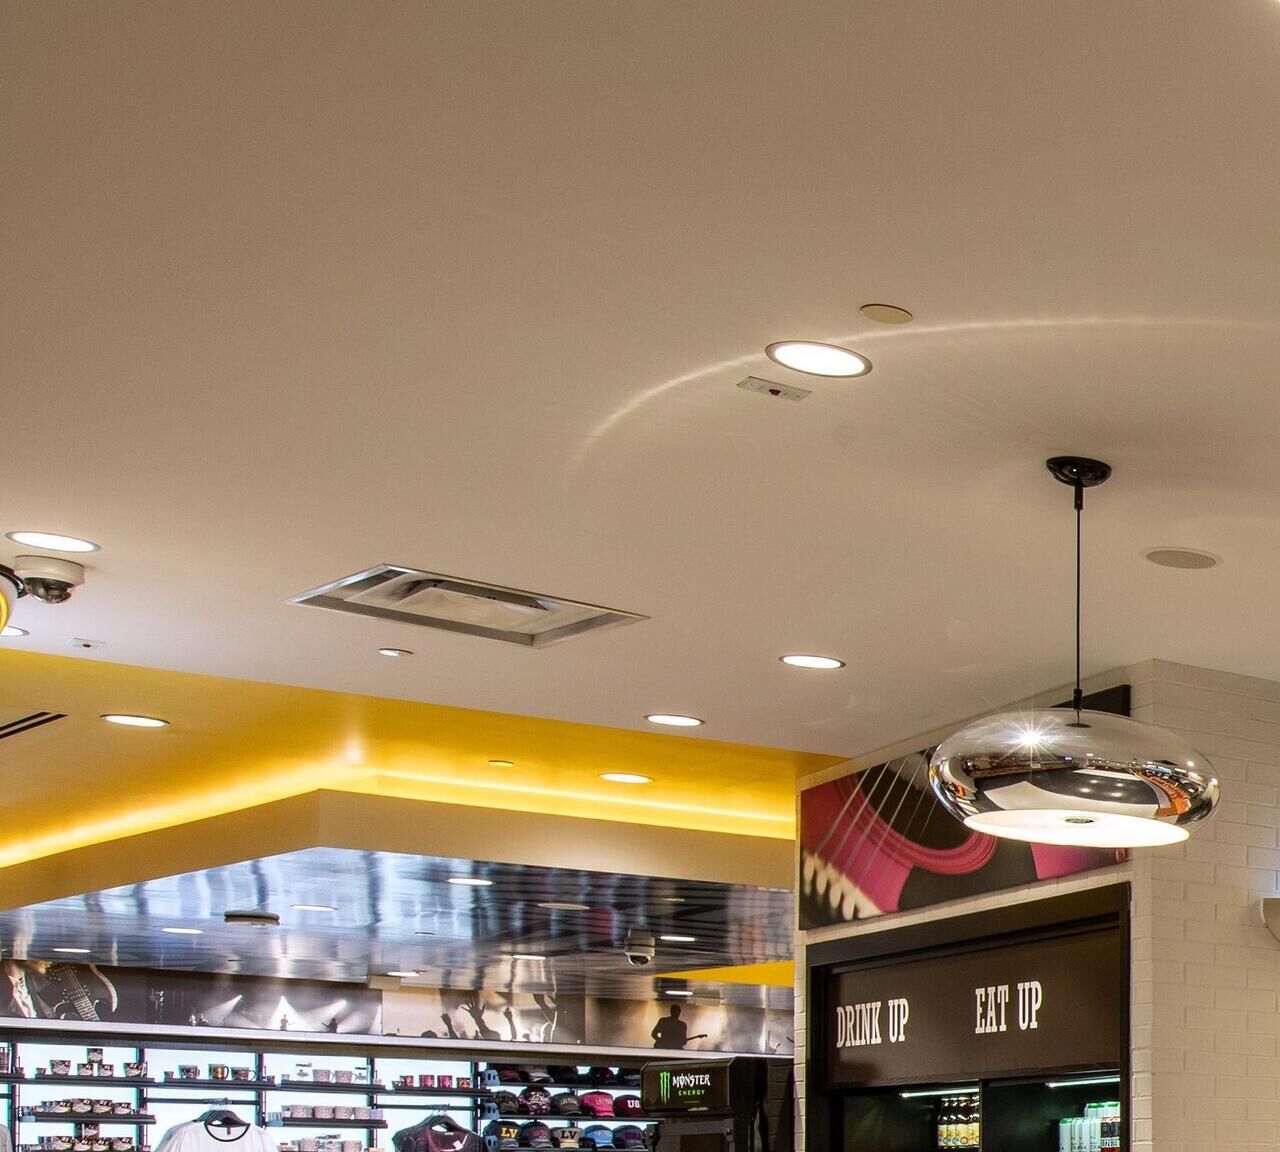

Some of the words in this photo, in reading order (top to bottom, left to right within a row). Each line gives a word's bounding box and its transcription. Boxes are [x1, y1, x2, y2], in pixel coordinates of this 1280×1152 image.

[975, 984, 1009, 1034] EAT
[1018, 980, 1043, 1031] UP
[836, 1001, 882, 1048] DRINK
[888, 998, 909, 1043] UP
[678, 1088, 705, 1096] ENERGY
[500, 1127, 518, 1138] LV
[561, 1130, 577, 1140] LV
